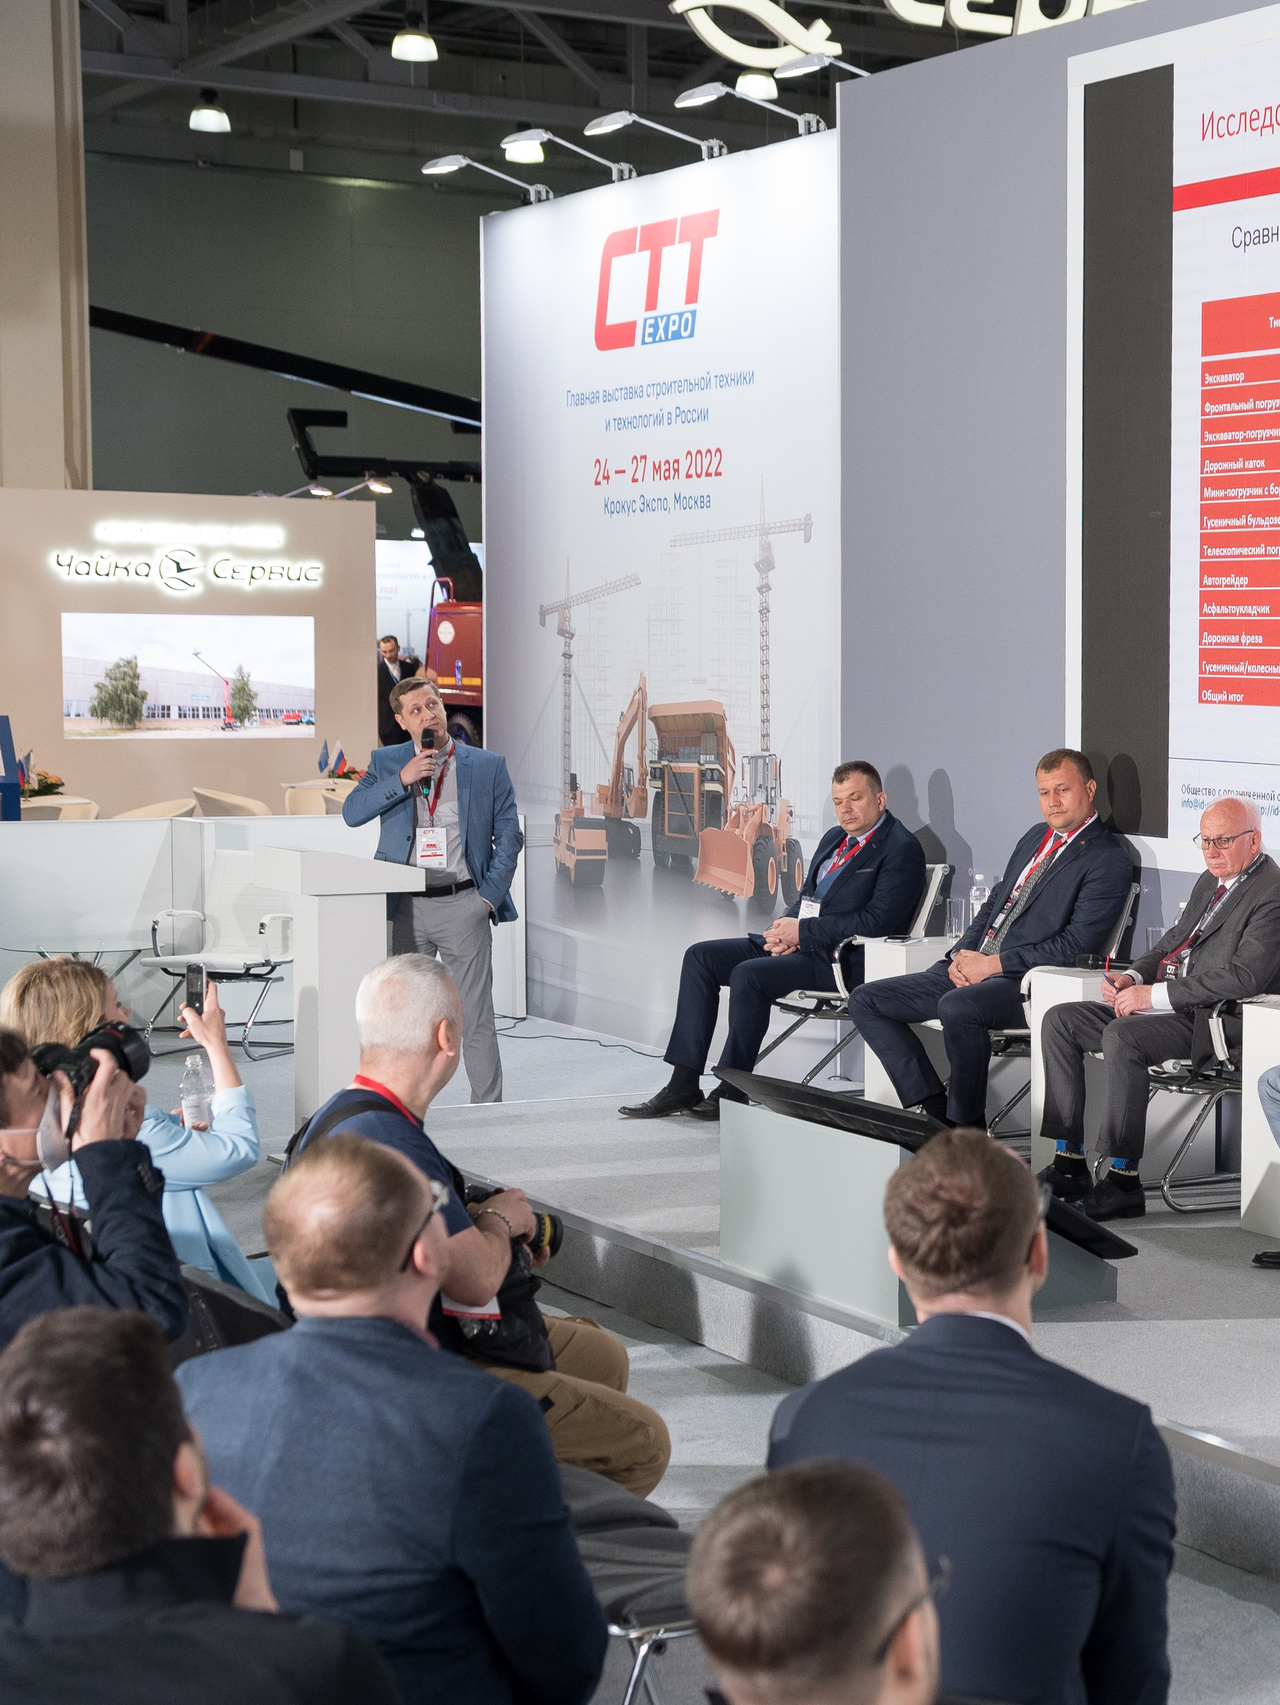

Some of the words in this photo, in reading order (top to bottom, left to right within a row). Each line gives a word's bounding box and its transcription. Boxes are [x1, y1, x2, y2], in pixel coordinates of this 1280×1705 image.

[594, 208, 720, 351] CTT
[644, 311, 693, 343] EXPO
[1204, 370, 1245, 385] Экскаватор
[566, 390, 600, 408] Главная
[602, 383, 644, 403] выставка
[645, 370, 712, 401] строительной
[713, 369, 755, 389] техники
[1204, 398, 1254, 414] Фронтальный
[605, 418, 611, 433] и
[613, 407, 665, 432] технологий
[667, 411, 673, 426] в
[674, 406, 709, 425] России
[593, 457, 611, 486] 24
[631, 454, 648, 483] 27
[652, 458, 680, 482] мая
[685, 447, 723, 479] 2022
[1203, 457, 1243, 474] Дорожный
[1245, 458, 1265, 469] каток
[1203, 484, 1263, 499] Мини-погрузчик
[603, 496, 636, 519] Крокус
[639, 494, 671, 515] Экспо,
[673, 491, 711, 511] Москва
[1203, 514, 1246, 528] Гусеничный
[1203, 543, 1265, 557] Телескопический
[55, 553, 152, 578] Чайка
[212, 558, 321, 586] Сервис
[1202, 574, 1249, 588] Автогрейдер
[1202, 603, 1270, 617] Асфальтоукладчик
[1202, 632, 1240, 646] Дорожная
[1241, 632, 1263, 646] фреза
[1201, 689, 1227, 704] Общий
[1228, 692, 1245, 703] итог
[1180, 783, 1216, 797] Общество
